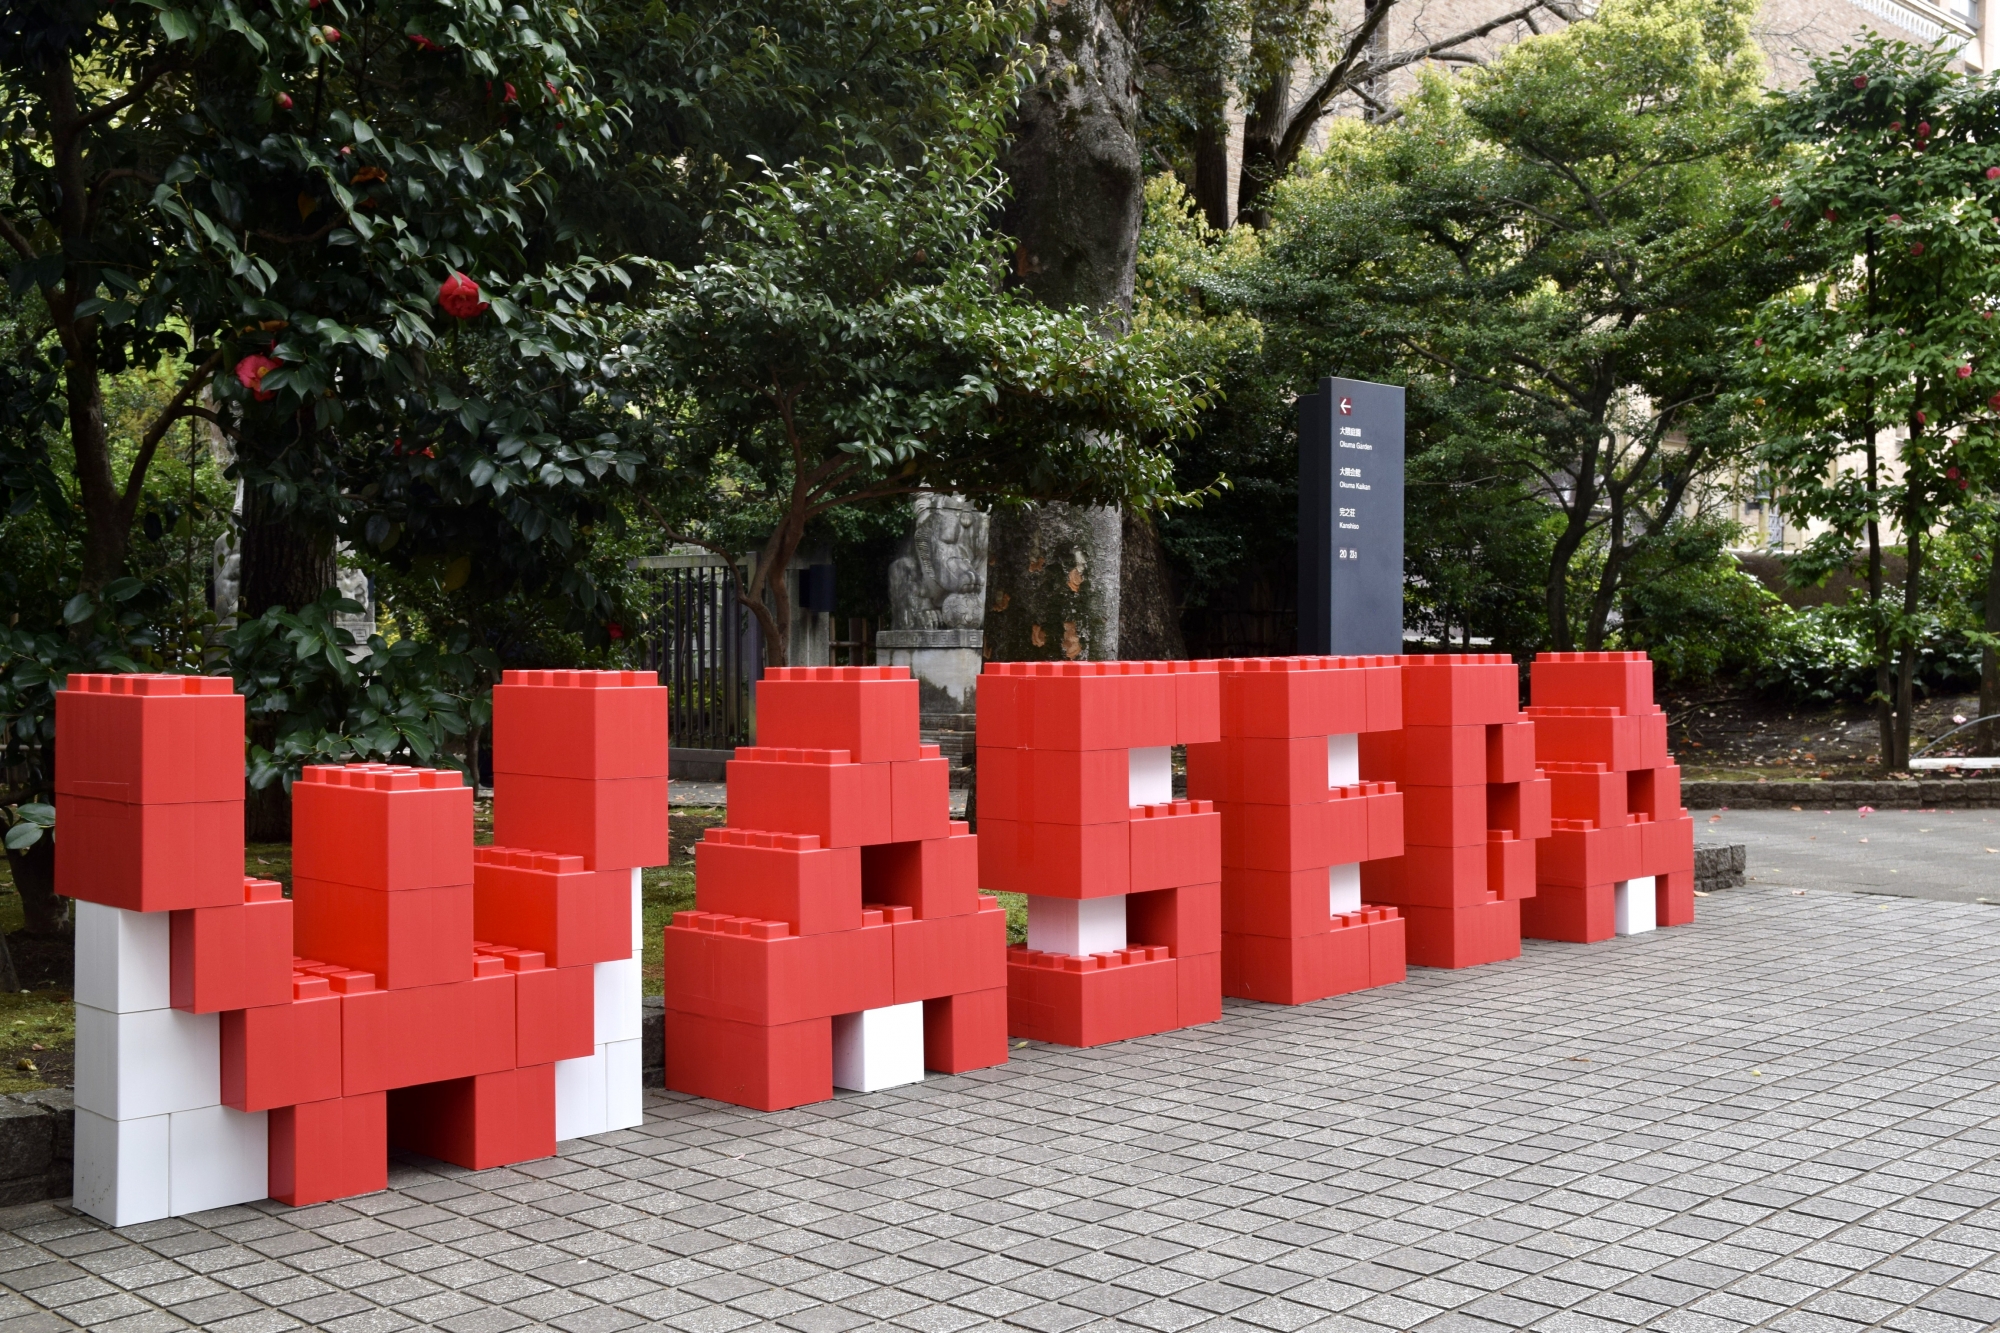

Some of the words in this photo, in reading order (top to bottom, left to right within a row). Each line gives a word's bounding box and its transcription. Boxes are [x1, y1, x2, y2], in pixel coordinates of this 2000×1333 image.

[1339, 440, 1355, 449] Okuma
[1356, 442, 1372, 451] Garden
[1339, 481, 1355, 489] Okuma
[1356, 482, 1371, 490] Kaikan
[1339, 521, 1359, 530] Kanshiso
[1339, 549, 1347, 558] 20
